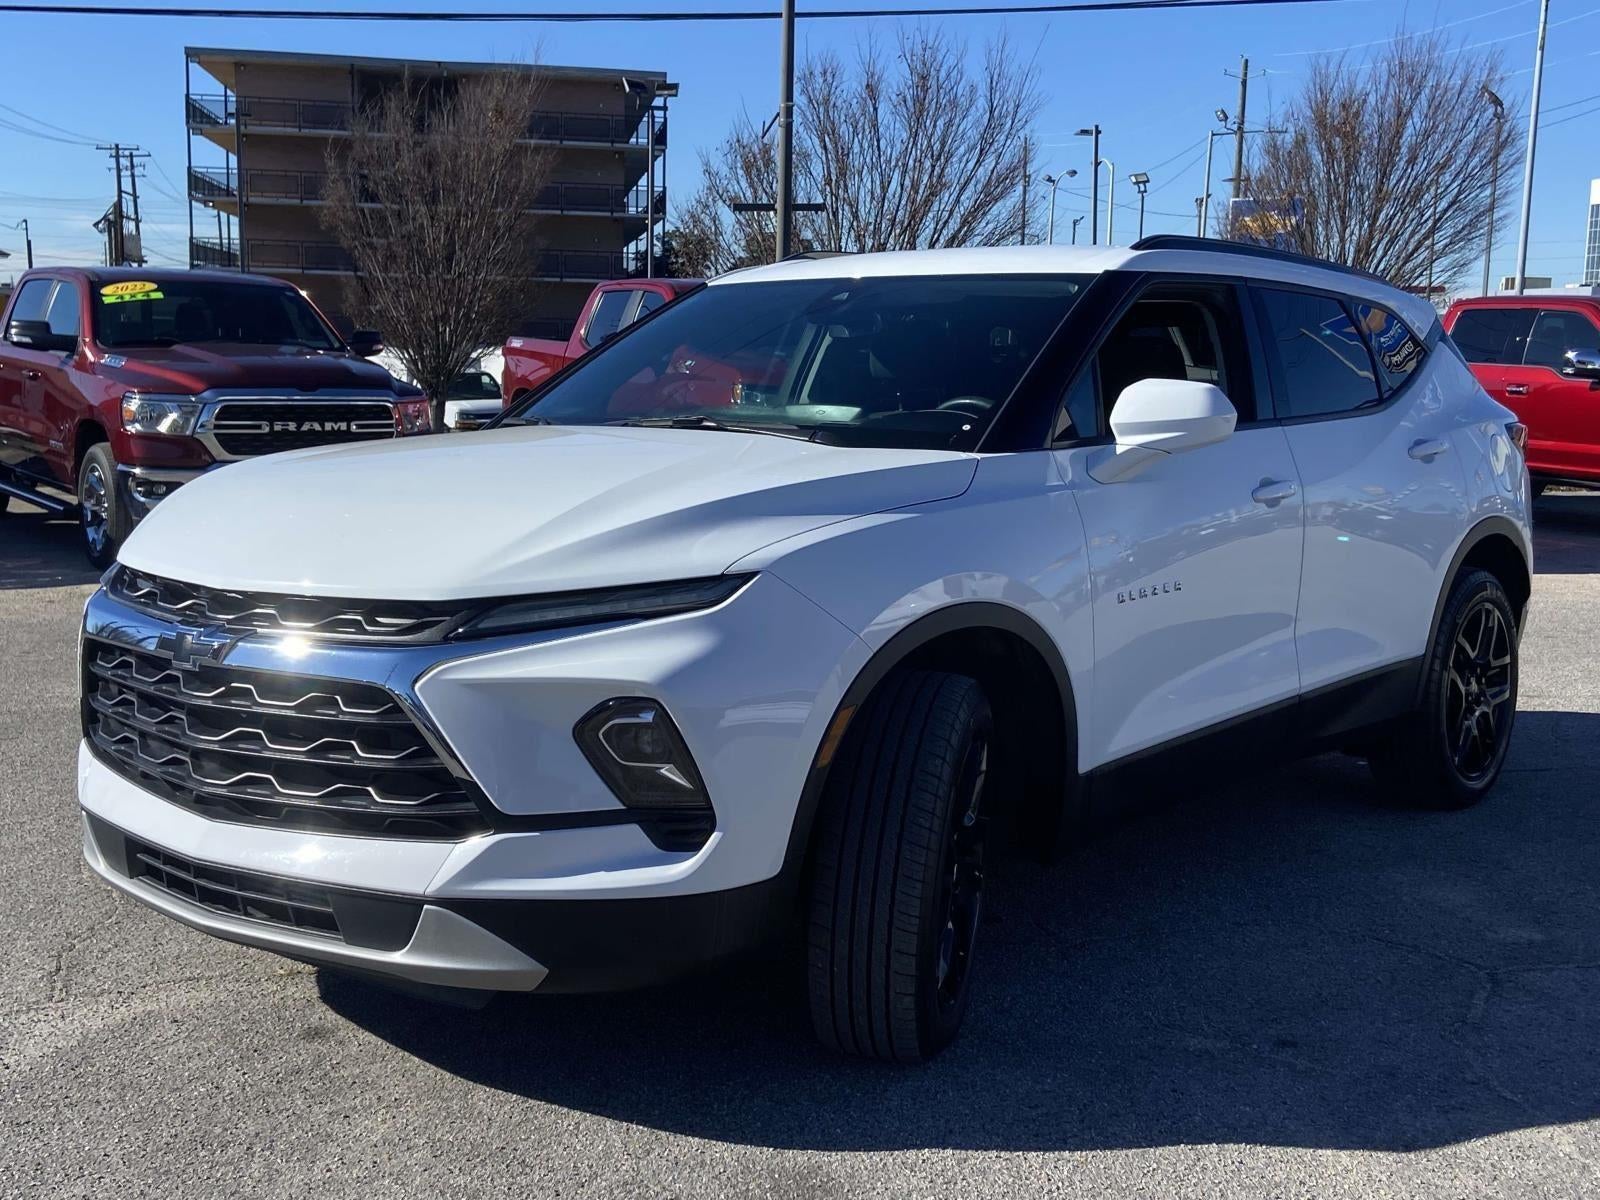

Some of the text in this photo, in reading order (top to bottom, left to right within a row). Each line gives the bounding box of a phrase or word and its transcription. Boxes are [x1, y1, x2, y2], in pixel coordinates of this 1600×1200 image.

[112, 283, 146, 294] 2022
[273, 421, 347, 431] RAM
[1117, 580, 1182, 604] BLAZER
